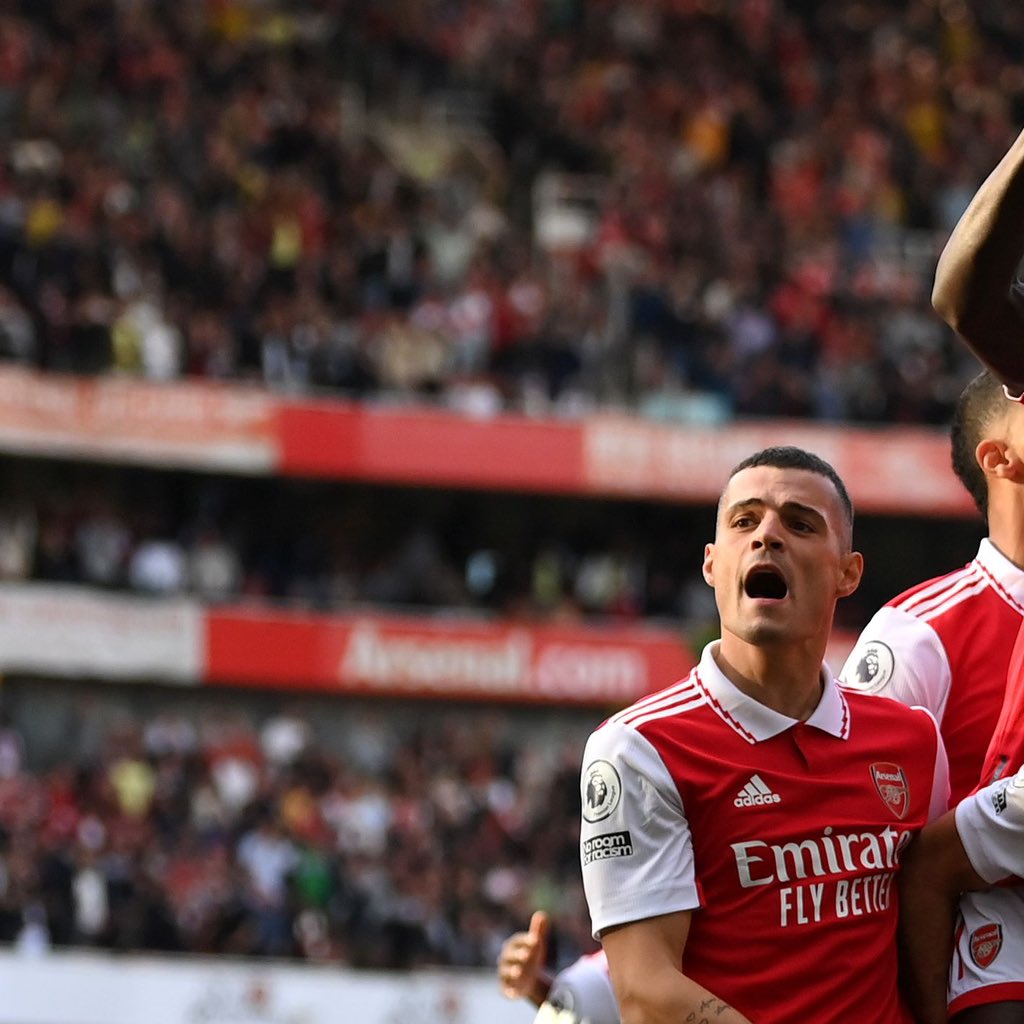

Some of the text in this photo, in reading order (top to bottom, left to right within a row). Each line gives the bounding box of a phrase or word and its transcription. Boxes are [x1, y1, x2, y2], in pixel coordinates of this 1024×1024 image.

[876, 771, 902, 782] Arsenal
[733, 793, 781, 808] adidas
[729, 825, 911, 889] Emirate
[780, 883, 824, 927] FLY
